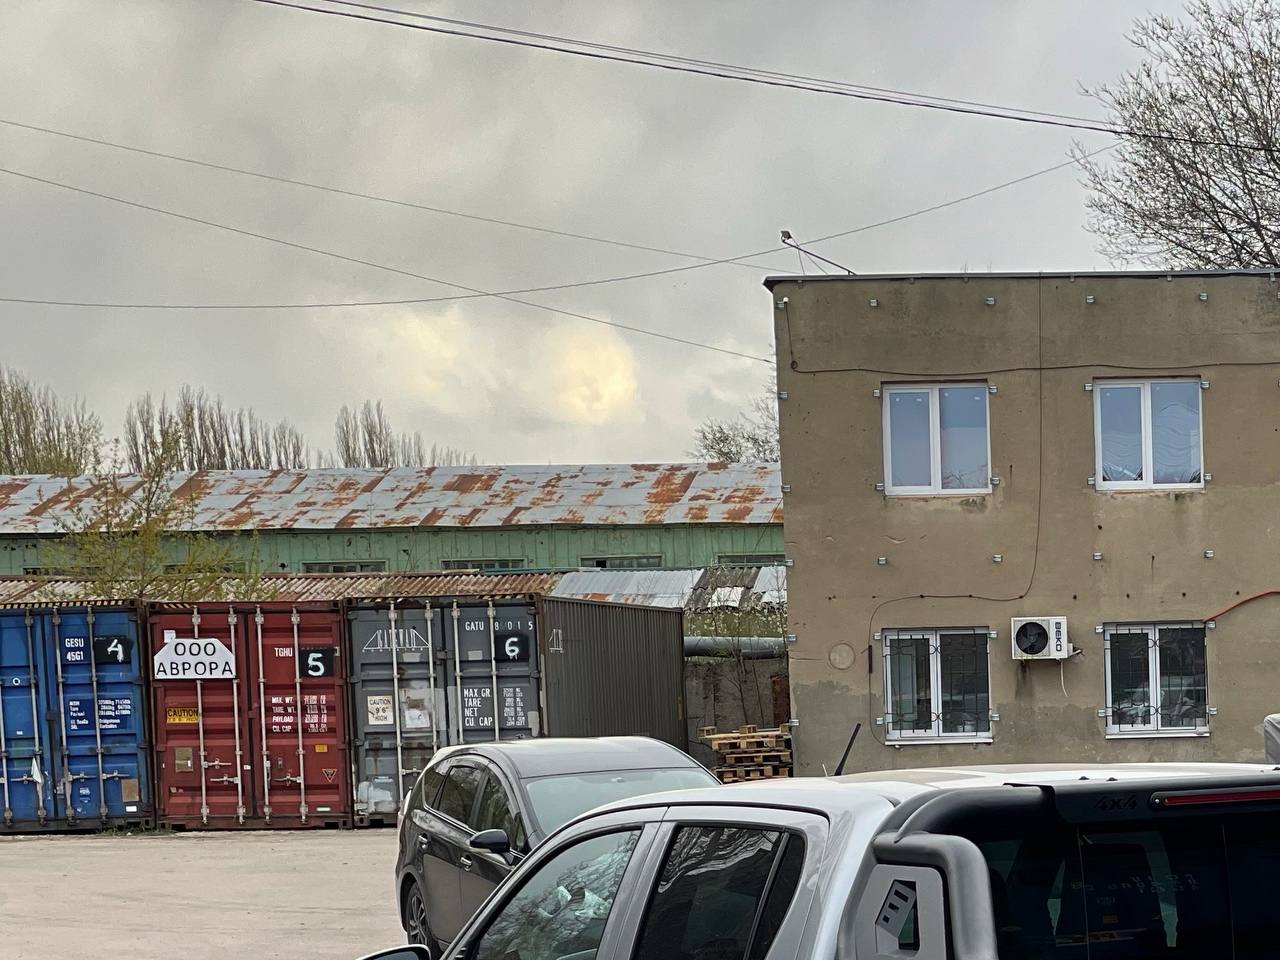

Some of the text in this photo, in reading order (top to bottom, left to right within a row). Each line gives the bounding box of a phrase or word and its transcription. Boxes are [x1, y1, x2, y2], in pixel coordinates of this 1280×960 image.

[465, 621, 484, 631] GATU
[65, 638, 84, 648] GESU
[505, 637, 519, 656] 6
[107, 639, 124, 662] 4
[174, 642, 216, 656] ООО
[274, 647, 293, 657] TGHU
[66, 651, 84, 661] 45G1
[156, 661, 233, 676] АВРОРА
[308, 653, 325, 676] 5
[464, 698, 482, 707] TARE
[167, 709, 199, 718] CAUTION
[464, 708, 478, 717] NET
